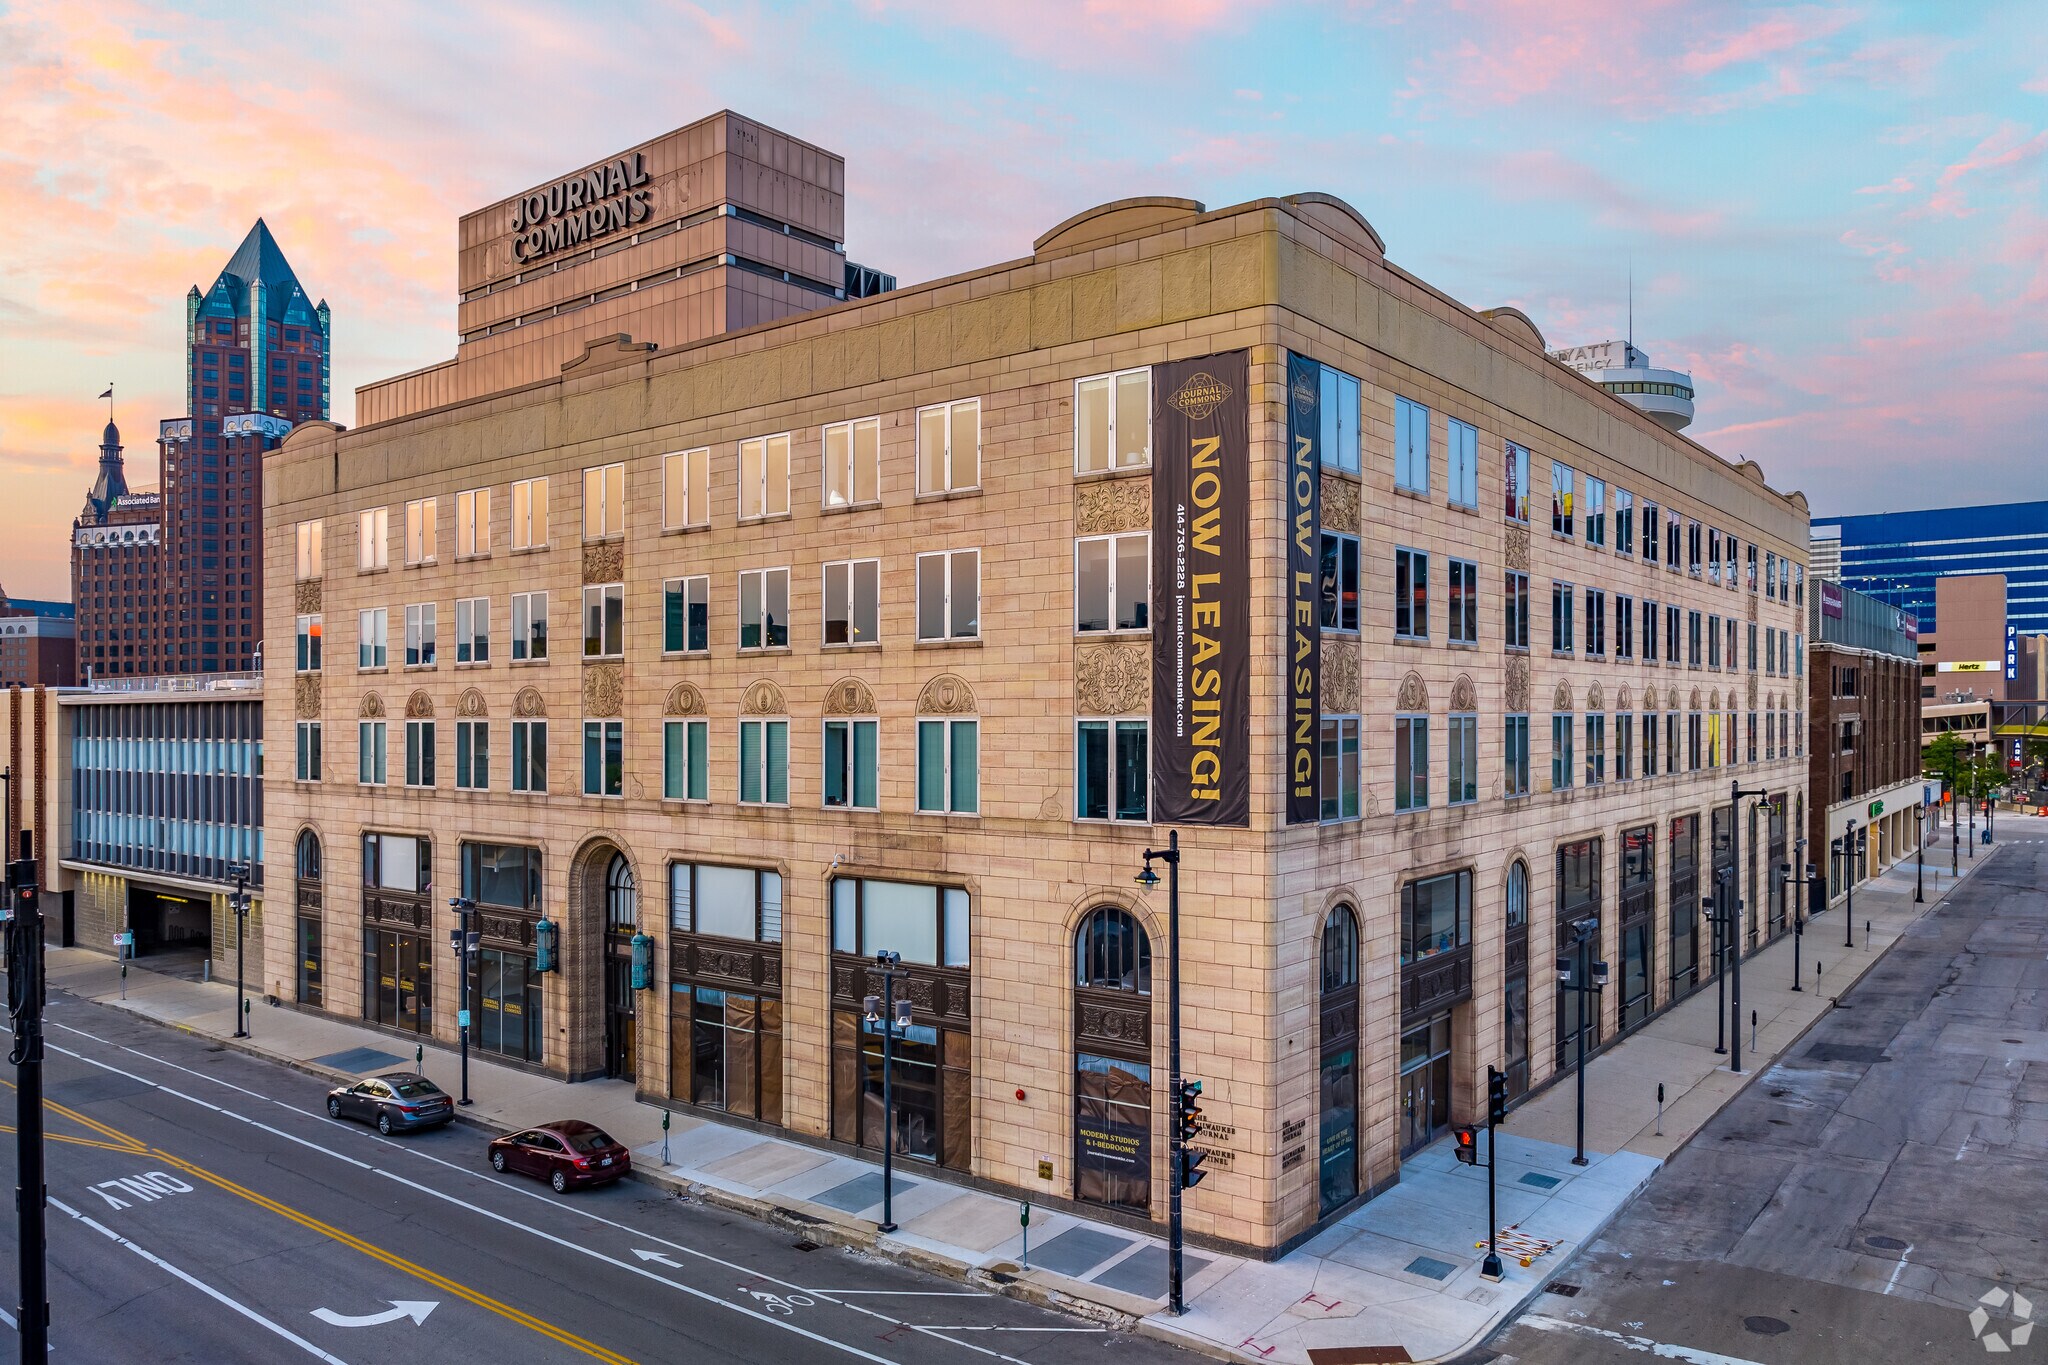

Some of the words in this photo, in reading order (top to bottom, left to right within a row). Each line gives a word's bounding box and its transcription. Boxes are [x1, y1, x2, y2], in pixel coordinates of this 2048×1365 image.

[511, 153, 649, 233] JOURNAL
[511, 189, 649, 264] COMMONS
[1179, 386, 1221, 399] JOURNAL
[1179, 394, 1221, 407] COMMONS
[117, 497, 149, 505] Associated
[1192, 435, 1220, 556] NOW
[1296, 435, 1312, 557] NOW
[1177, 504, 1185, 589] 414-736-2228
[1175, 595, 1185, 737] journalcommonsmke.com
[1190, 573, 1221, 800] LEASING!
[1295, 571, 1312, 798] LEASING!
[1080, 1129, 1109, 1140] MODERN
[1110, 1134, 1140, 1146] STUDIOS
[1198, 1130, 1228, 1140] OURNAL
[1205, 1156, 1228, 1165] TINEL
[86, 1171, 193, 1210] ONLY
